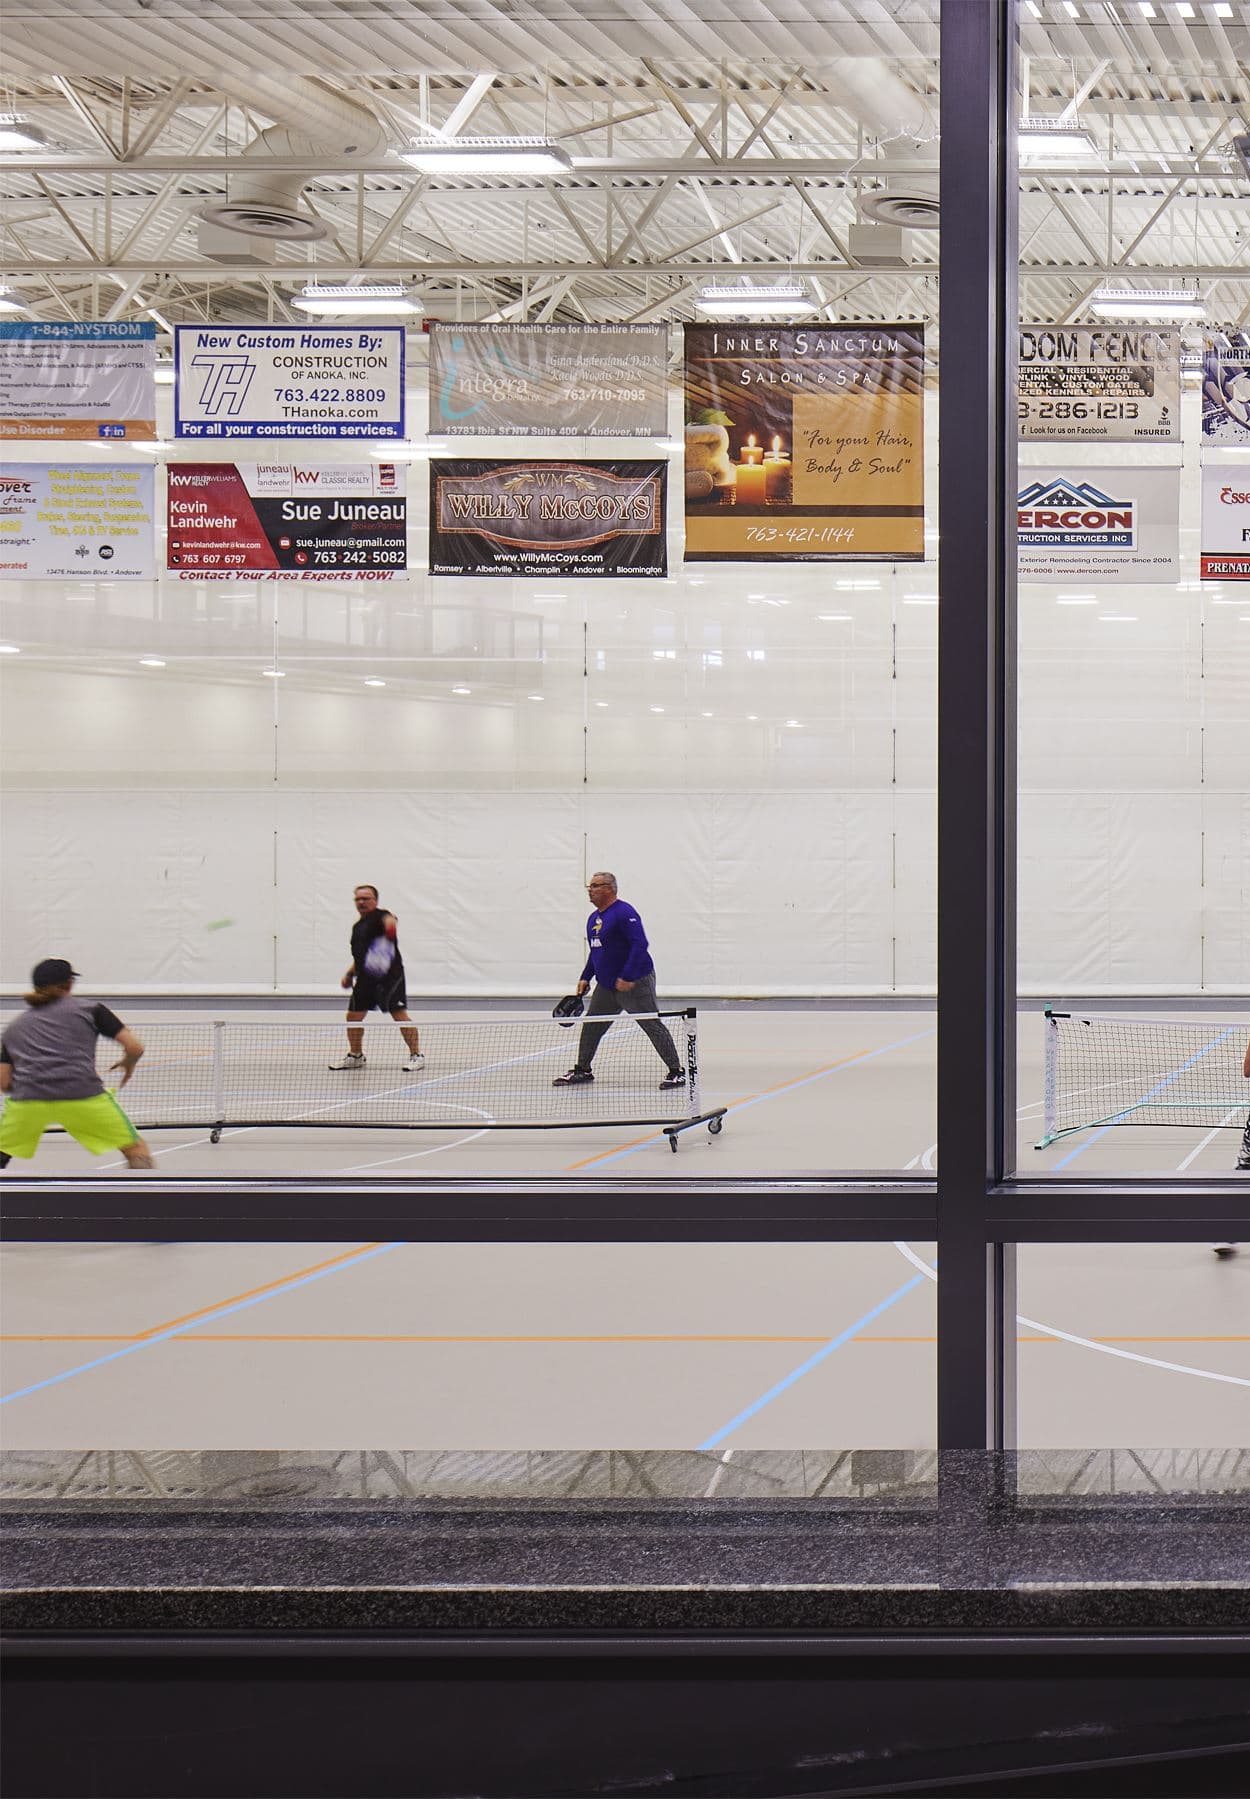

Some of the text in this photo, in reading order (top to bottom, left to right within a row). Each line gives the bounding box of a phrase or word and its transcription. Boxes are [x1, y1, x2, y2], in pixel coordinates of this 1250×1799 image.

[435, 324, 660, 335] Providers Oral Health Care for the Entire Family
[197, 334, 382, 352] New Custom Homes By:
[1090, 333, 1171, 362] FENCE
[273, 357, 387, 368] CONSTRUCTION
[291, 371, 368, 381] OF ANOKA, INC.
[818, 374, 825, 383] &
[274, 389, 386, 402] 763.422.8809
[282, 406, 378, 418] THanoka.com
[182, 424, 397, 436] For all your construction services.
[1077, 426, 1108, 434] Facebook
[836, 437, 869, 454] your
[876, 429, 912, 448] Hair,
[294, 466, 319, 483] kw
[805, 458, 842, 482] Body
[848, 460, 862, 473] &
[171, 474, 192, 486] kw
[171, 501, 207, 512] Kevin
[282, 501, 405, 521] Sue Juneau
[448, 494, 650, 520] WILLY McCOYS
[171, 516, 237, 528] Landwehr
[745, 528, 855, 542] 763-421-1144
[296, 538, 405, 548] sue.juneau@gmail.com
[183, 555, 245, 564] 763 607 6797
[314, 552, 405, 563] 763 242 5082
[494, 553, 603, 563] www.WillyMcCoys.com
[179, 571, 393, 581] Contact Your Area Experts NOW!
[433, 565, 463, 573] Ramsey
[525, 565, 560, 574] Champlin
[617, 566, 662, 575] Bloomington
